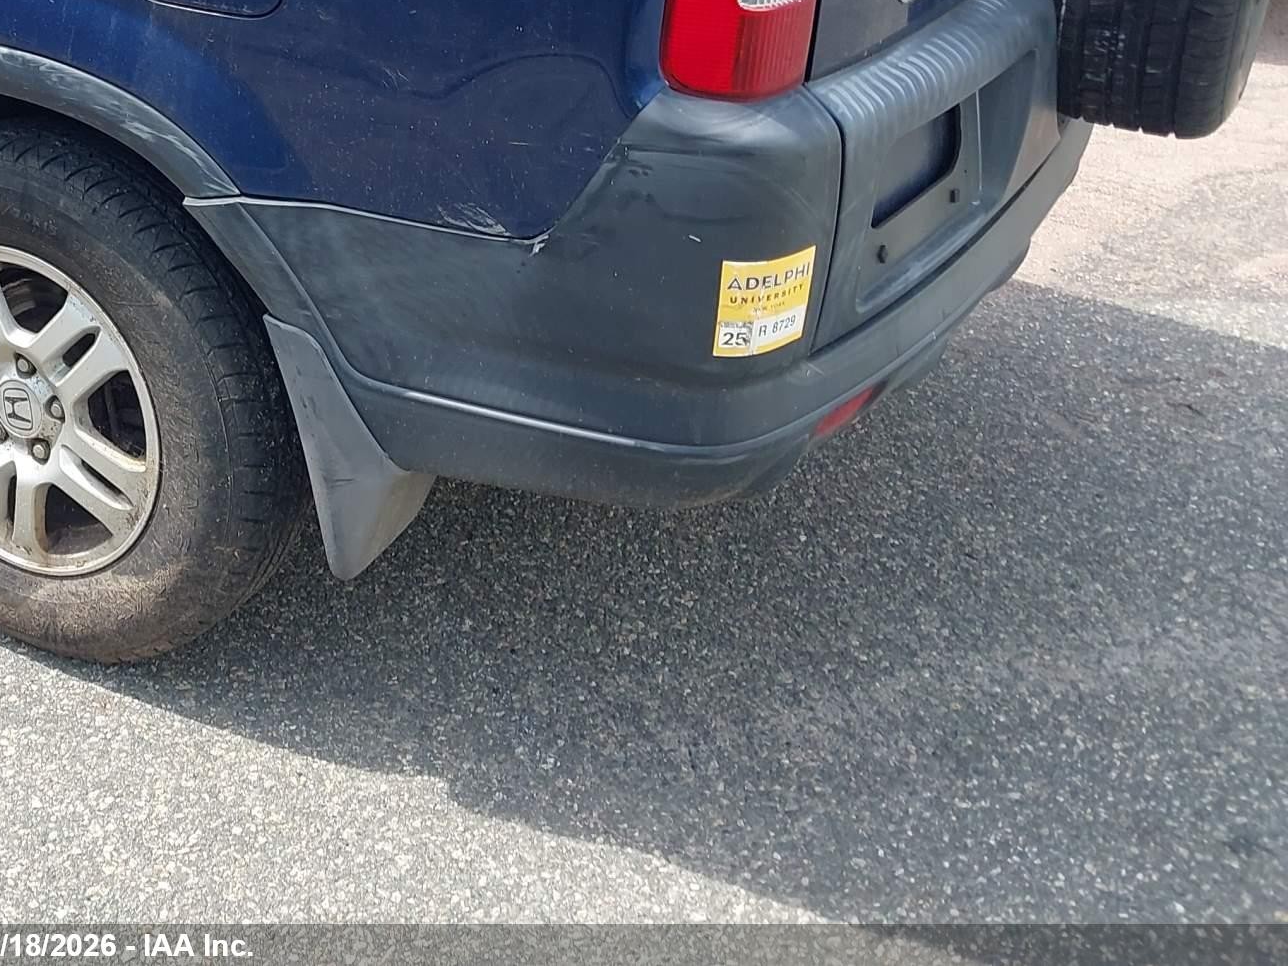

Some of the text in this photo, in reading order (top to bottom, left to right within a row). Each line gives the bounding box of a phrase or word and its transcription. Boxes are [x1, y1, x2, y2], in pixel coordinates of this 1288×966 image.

[727, 262, 811, 291] ADELPHI
[729, 283, 805, 305] UNIVERSITY
[721, 332, 748, 346] 25
[758, 324, 767, 337] R
[772, 314, 797, 334] 8729
